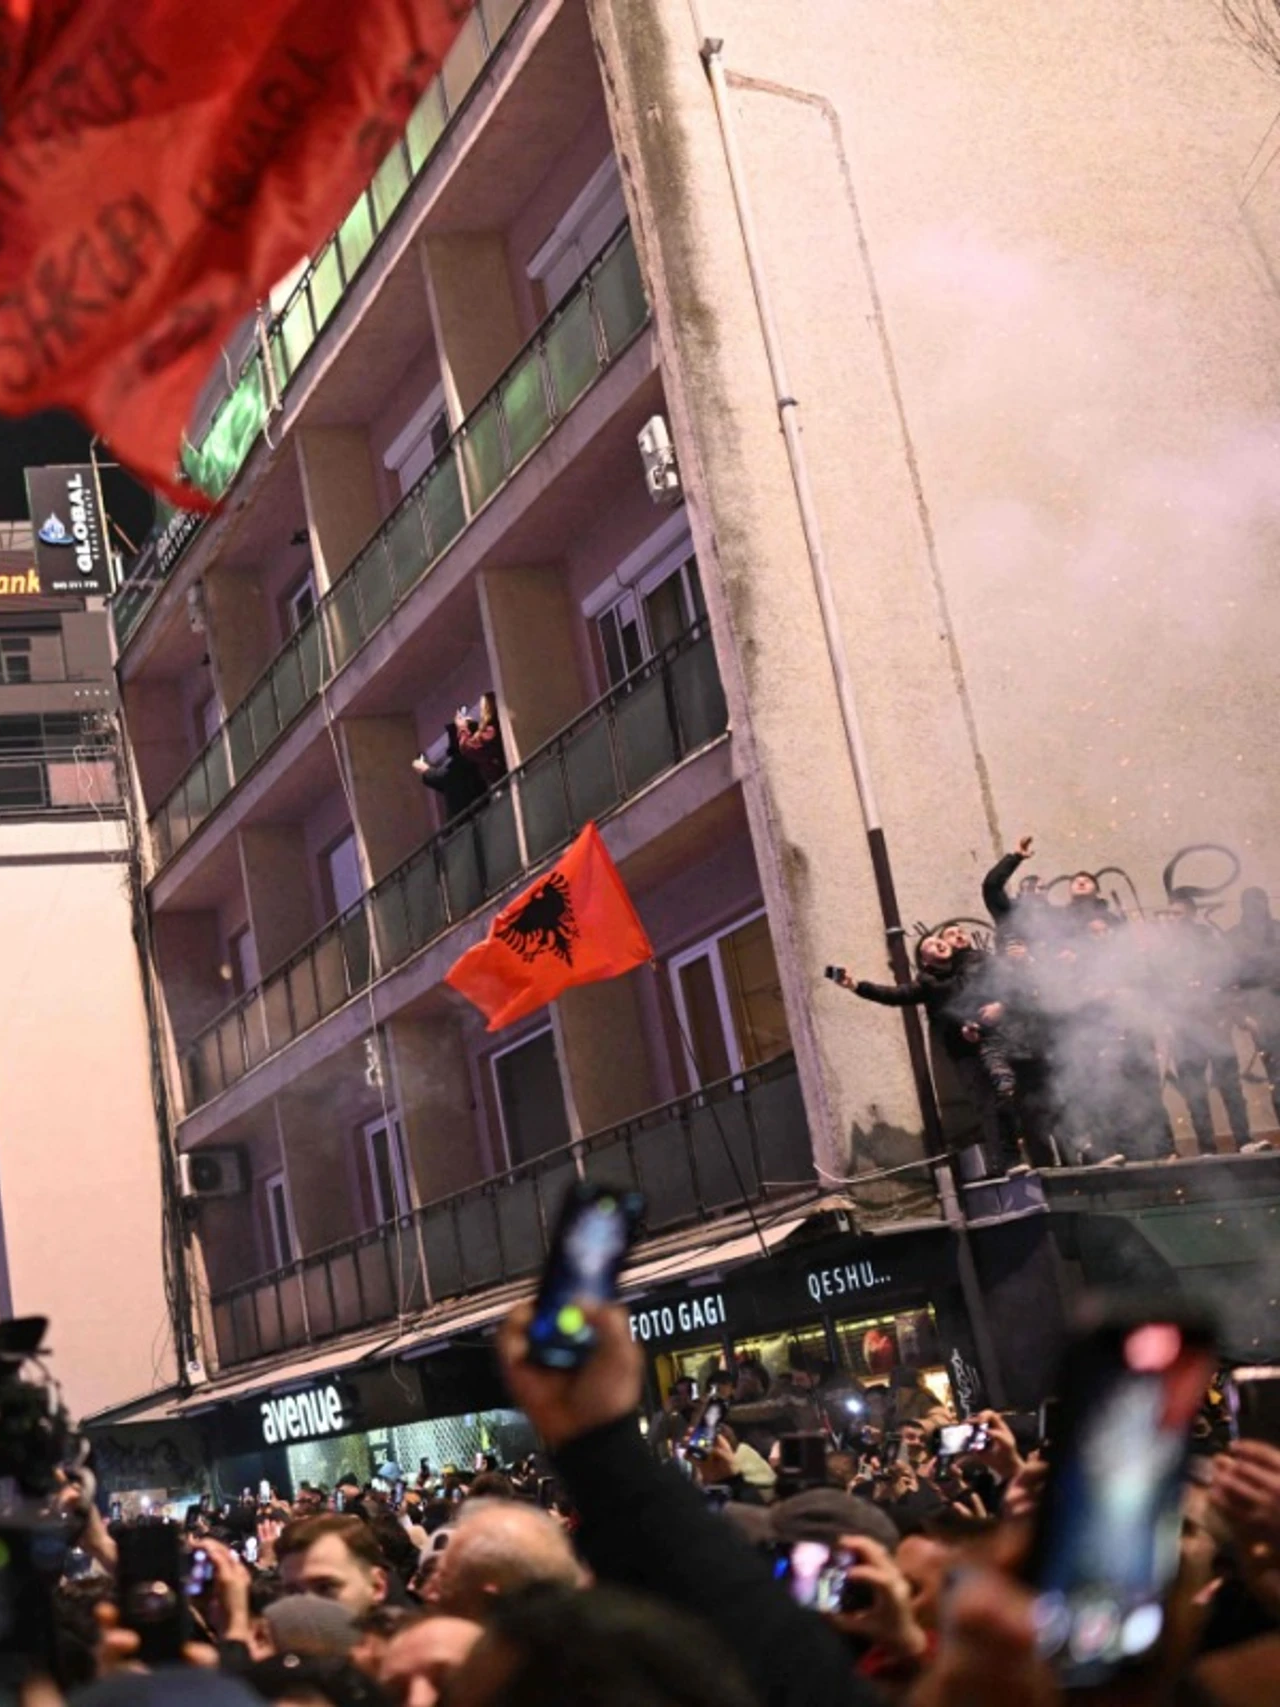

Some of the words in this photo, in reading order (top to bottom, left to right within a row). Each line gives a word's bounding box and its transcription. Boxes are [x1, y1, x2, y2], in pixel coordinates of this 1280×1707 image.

[66, 473, 93, 573] GLOBAL
[629, 1307, 675, 1343] FOTO
[678, 1293, 727, 1332] GAGI
[260, 1384, 344, 1444] avenue
